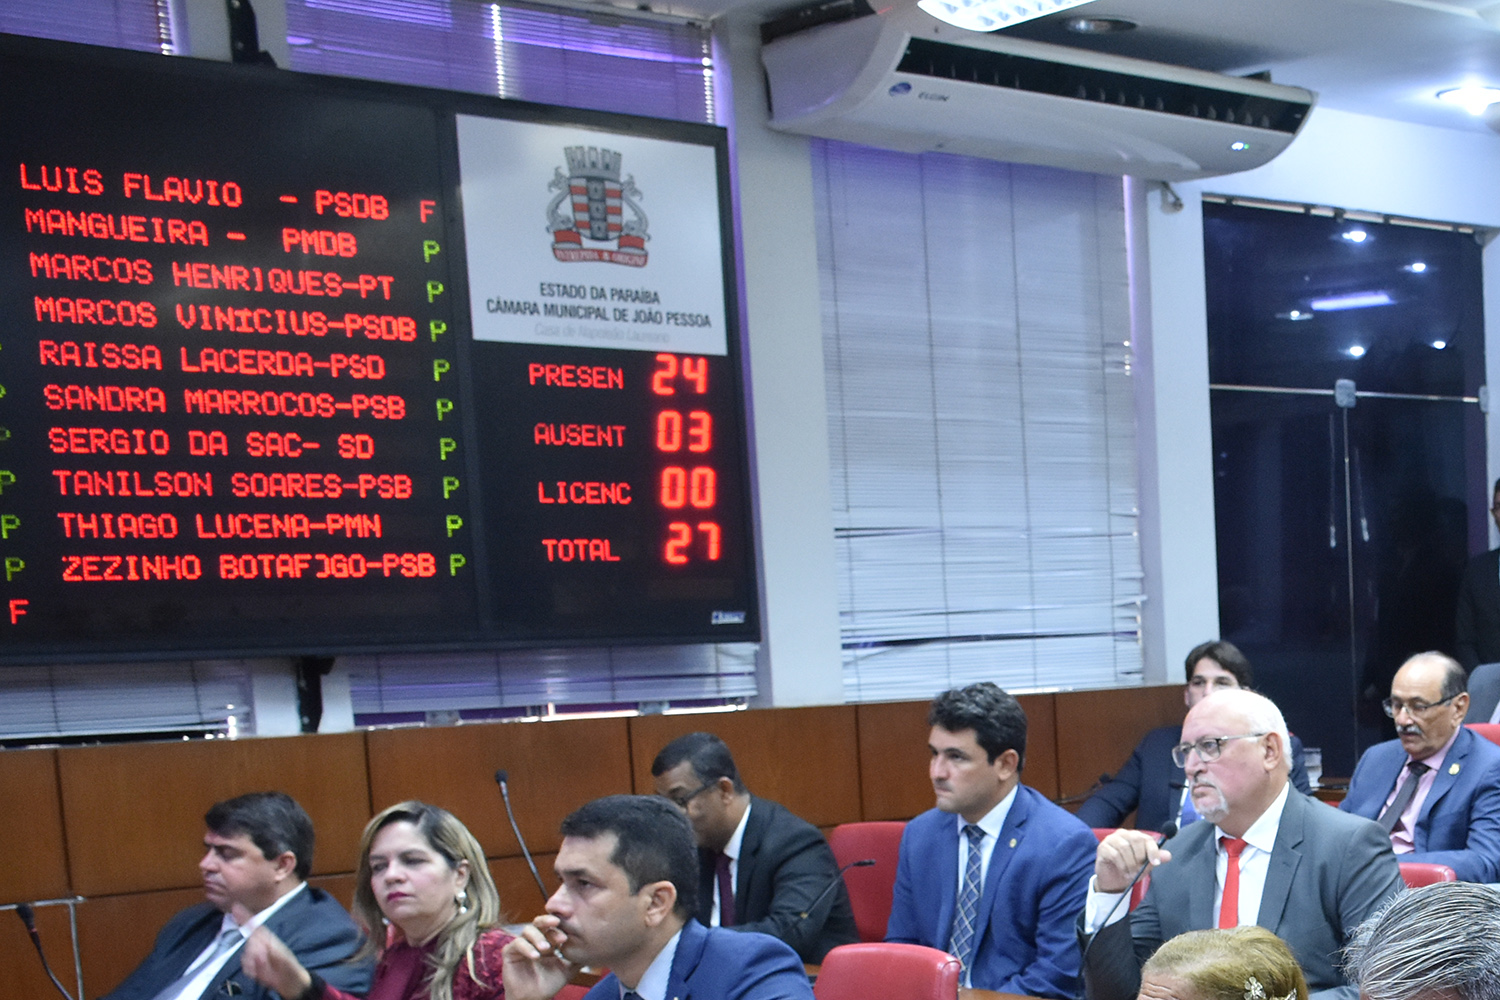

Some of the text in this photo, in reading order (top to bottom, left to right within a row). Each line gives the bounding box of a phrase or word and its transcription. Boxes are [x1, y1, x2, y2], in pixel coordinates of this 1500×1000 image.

[19, 162, 105, 196] LUIS
[123, 172, 243, 208] FLAVIO
[314, 189, 390, 221] PSDB
[420, 199, 436, 224] F
[24, 207, 210, 248] MANGUEIRA
[281, 227, 359, 258] PMDB
[423, 240, 441, 263] P
[29, 251, 155, 286] MARCOS
[426, 281, 445, 303] P
[540, 281, 661, 305] ESTADO DA PARAÍBA
[34, 295, 448, 343] MARCOS VINICIUS-PSDB P
[543, 303, 611, 321] MUNICIPAL
[613, 308, 629, 323] DE
[632, 307, 664, 325] JOÃO
[666, 311, 712, 328] PESSOA
[39, 339, 451, 382] RAISSA LACERDA-PSD P
[528, 354, 707, 395] PRESEN 24
[43, 383, 167, 414] SANDRA
[183, 388, 407, 420] MARROCOS-PSB
[436, 398, 454, 421] P
[47, 426, 457, 461] SERGIO DA SAC- SD P
[534, 409, 712, 453] AUSENT 03
[52, 469, 460, 500] TANILSON SOARES-PSB P
[537, 466, 716, 509] LICENC 00
[1, 514, 21, 540] P
[57, 512, 464, 539] THIAGO LUCENA-PMN P
[541, 522, 720, 564] TOTAL 27
[5, 558, 25, 581] P
[61, 554, 203, 582] ZEZINHO
[449, 553, 466, 576] P
[8, 599, 30, 625] F
